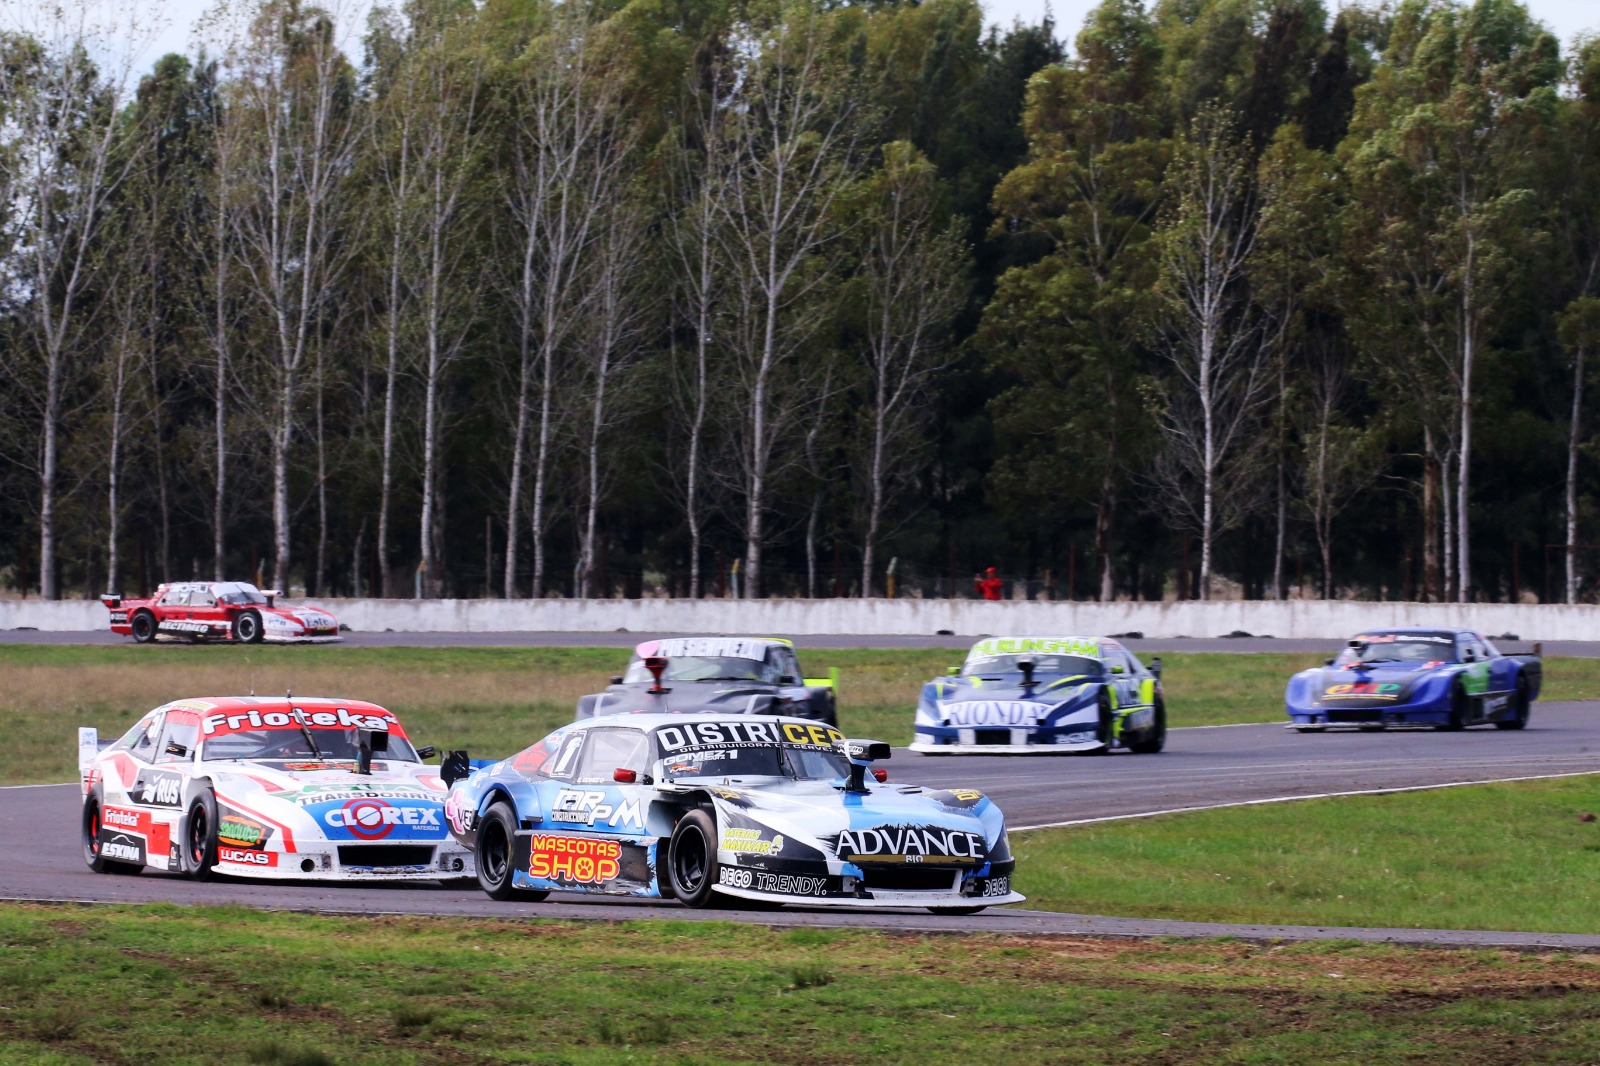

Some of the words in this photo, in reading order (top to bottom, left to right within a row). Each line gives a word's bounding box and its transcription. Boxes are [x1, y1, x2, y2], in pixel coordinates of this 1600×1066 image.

[203, 708, 387, 735] Frioteka
[663, 749, 725, 766] GOMEZ
[156, 778, 180, 804] RUS
[324, 806, 441, 828] CLOREX
[101, 842, 140, 862] ESKINA
[533, 836, 619, 858] MASCOTAS
[835, 829, 985, 859] ADVANCE
[221, 849, 269, 865] LUCAS
[531, 853, 618, 881] SHOP
[720, 866, 752, 888] DECO
